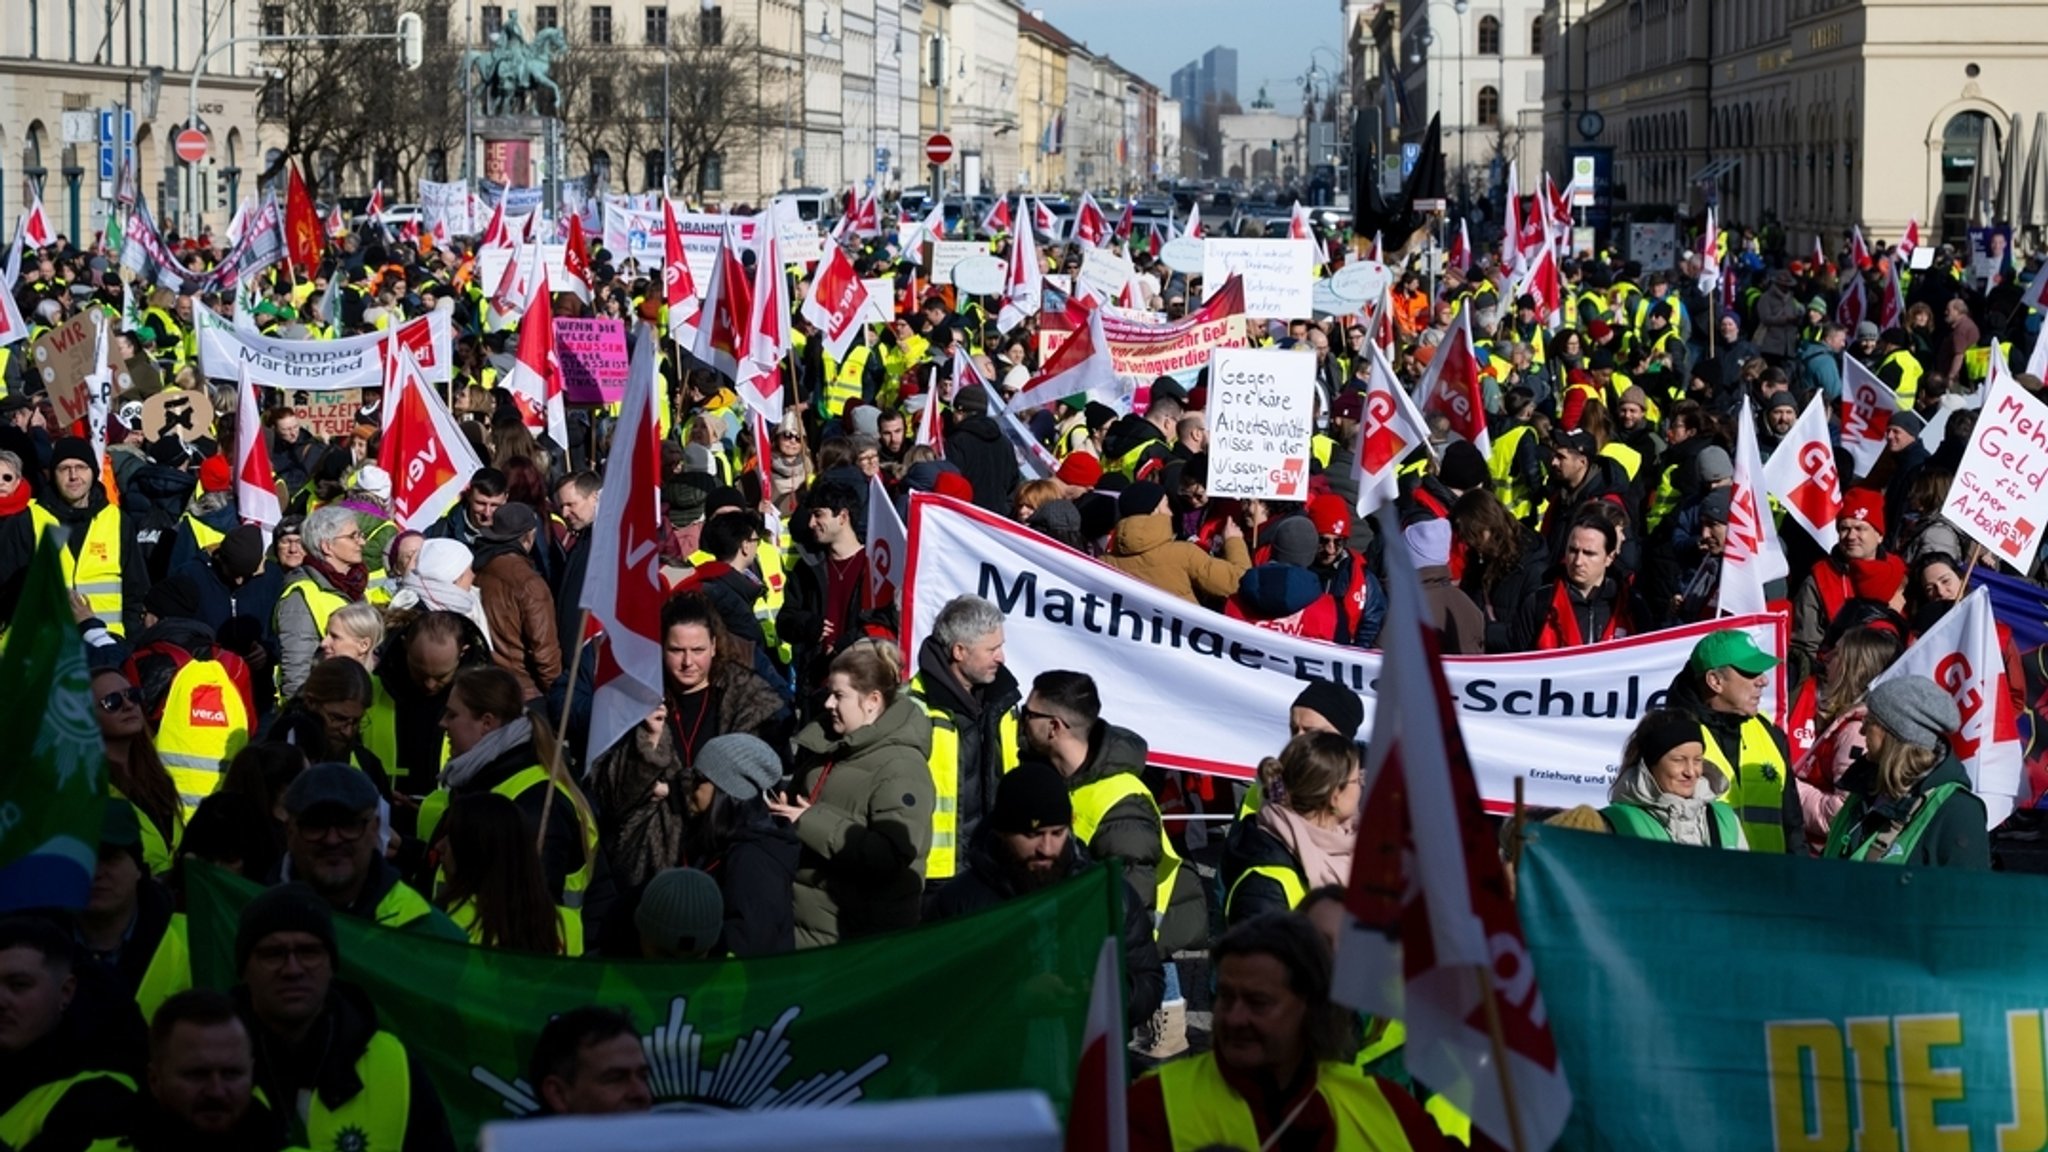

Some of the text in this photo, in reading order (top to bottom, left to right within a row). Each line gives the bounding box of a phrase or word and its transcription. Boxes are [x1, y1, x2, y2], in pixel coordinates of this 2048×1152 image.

[50, 321, 86, 353] WIR
[557, 321, 593, 332] WENN
[239, 346, 363, 378] Martinsried
[267, 346, 363, 366] Campus
[1220, 359, 1275, 394] Gegen
[1843, 385, 1878, 445] GEW
[1998, 395, 2048, 455] Meh
[1217, 435, 1303, 455] nisse in der
[1979, 425, 2048, 492] Geld
[1270, 469, 1305, 484] GEW
[1960, 471, 2008, 513] Super
[1995, 477, 2027, 502] für
[2000, 520, 2032, 550] GEW
[977, 560, 1670, 721] Mathilde-Ell-Schule
[1529, 768, 1582, 784] Erziehung
[1584, 775, 1605, 785] und
[1764, 1008, 2048, 1152] DIE J
